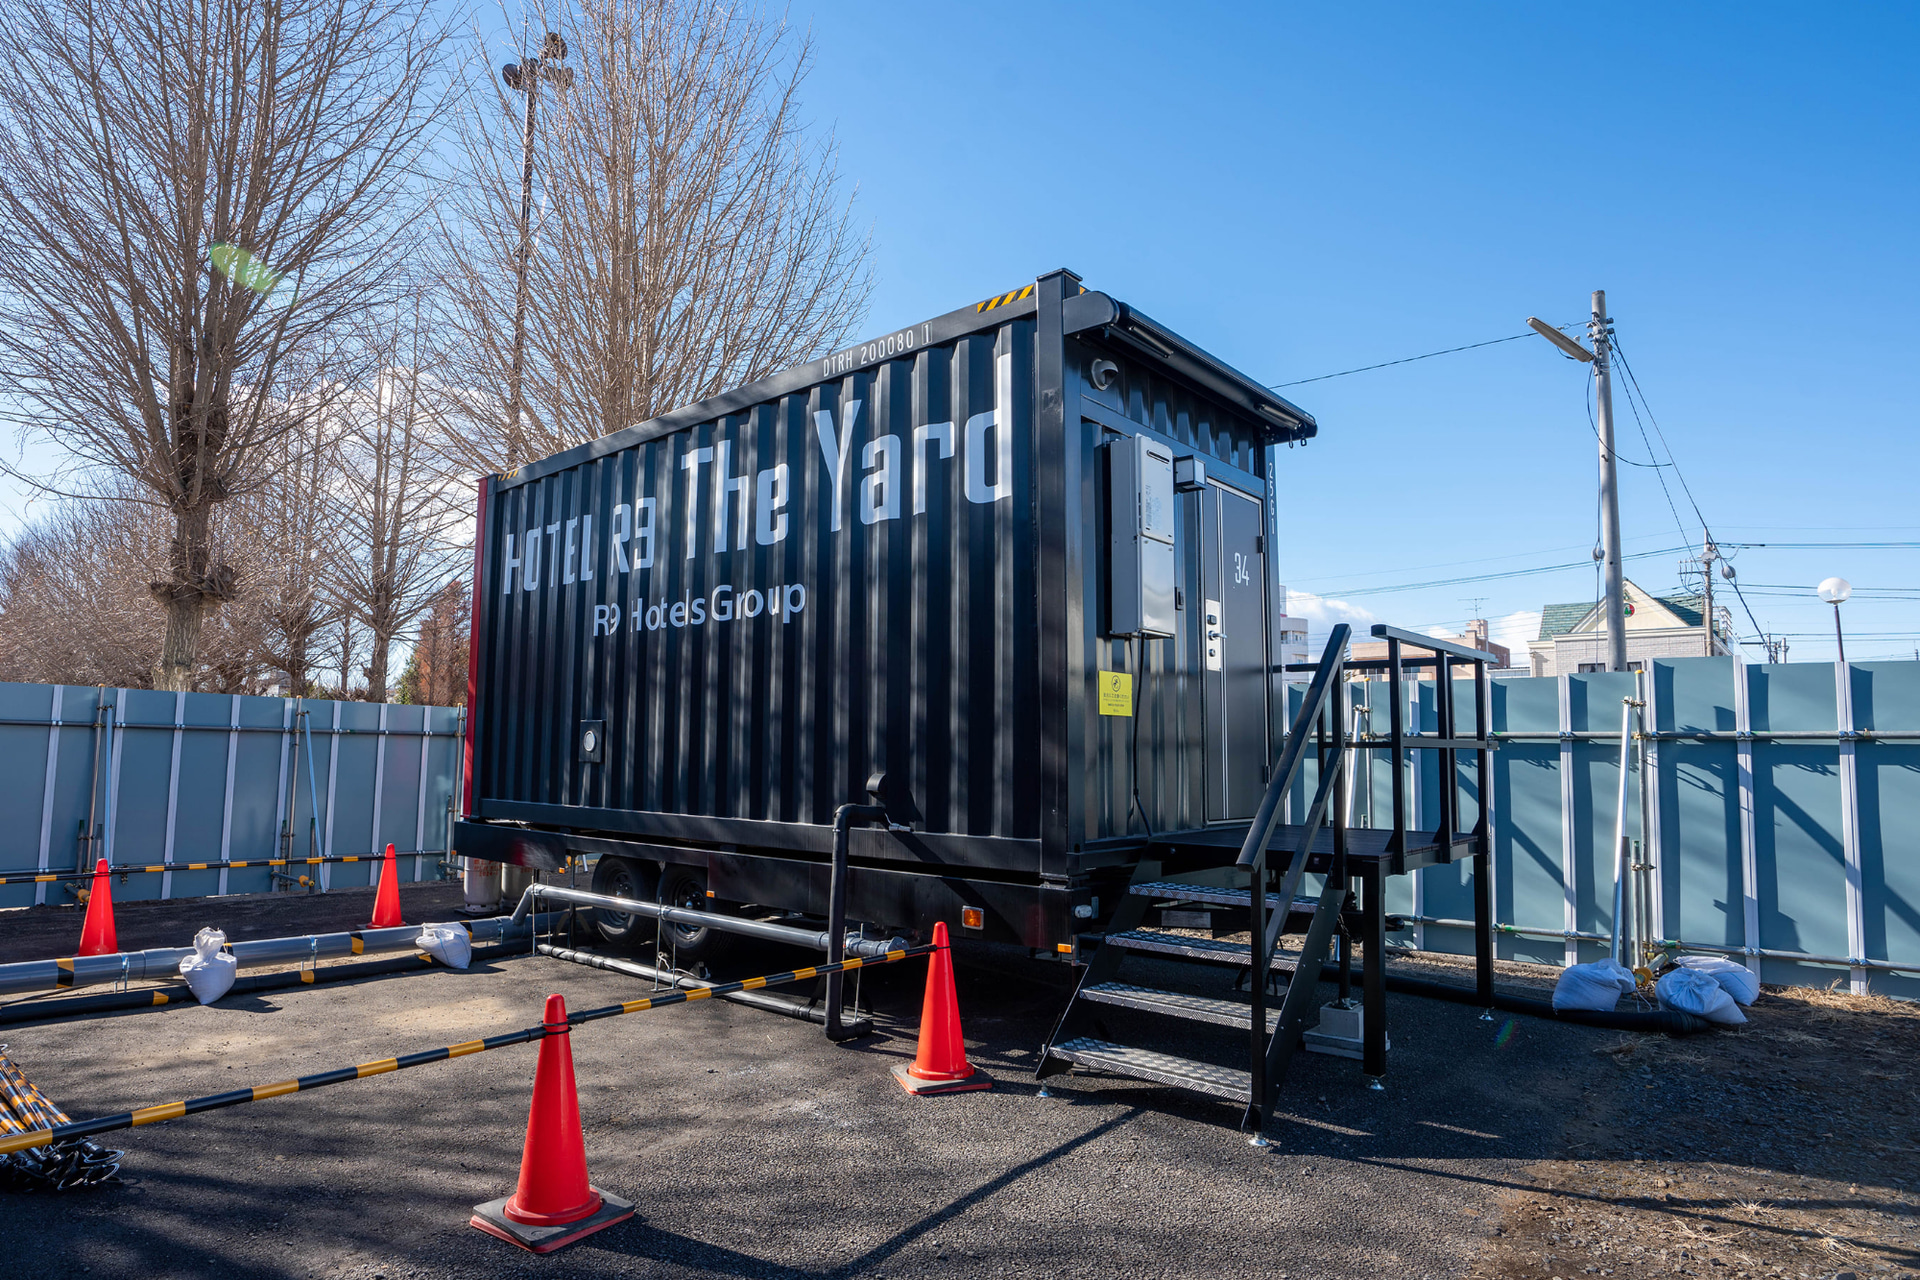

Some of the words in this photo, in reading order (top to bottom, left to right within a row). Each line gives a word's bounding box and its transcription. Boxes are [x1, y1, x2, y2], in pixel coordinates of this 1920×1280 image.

[823, 350, 853, 377] DTRH
[860, 329, 914, 365] 200080
[503, 514, 593, 595] HOTEL
[610, 497, 656, 576] R9
[680, 439, 790, 560] The
[813, 352, 1012, 532] Yard
[1234, 552, 1250, 586] 34
[593, 603, 621, 637] R9
